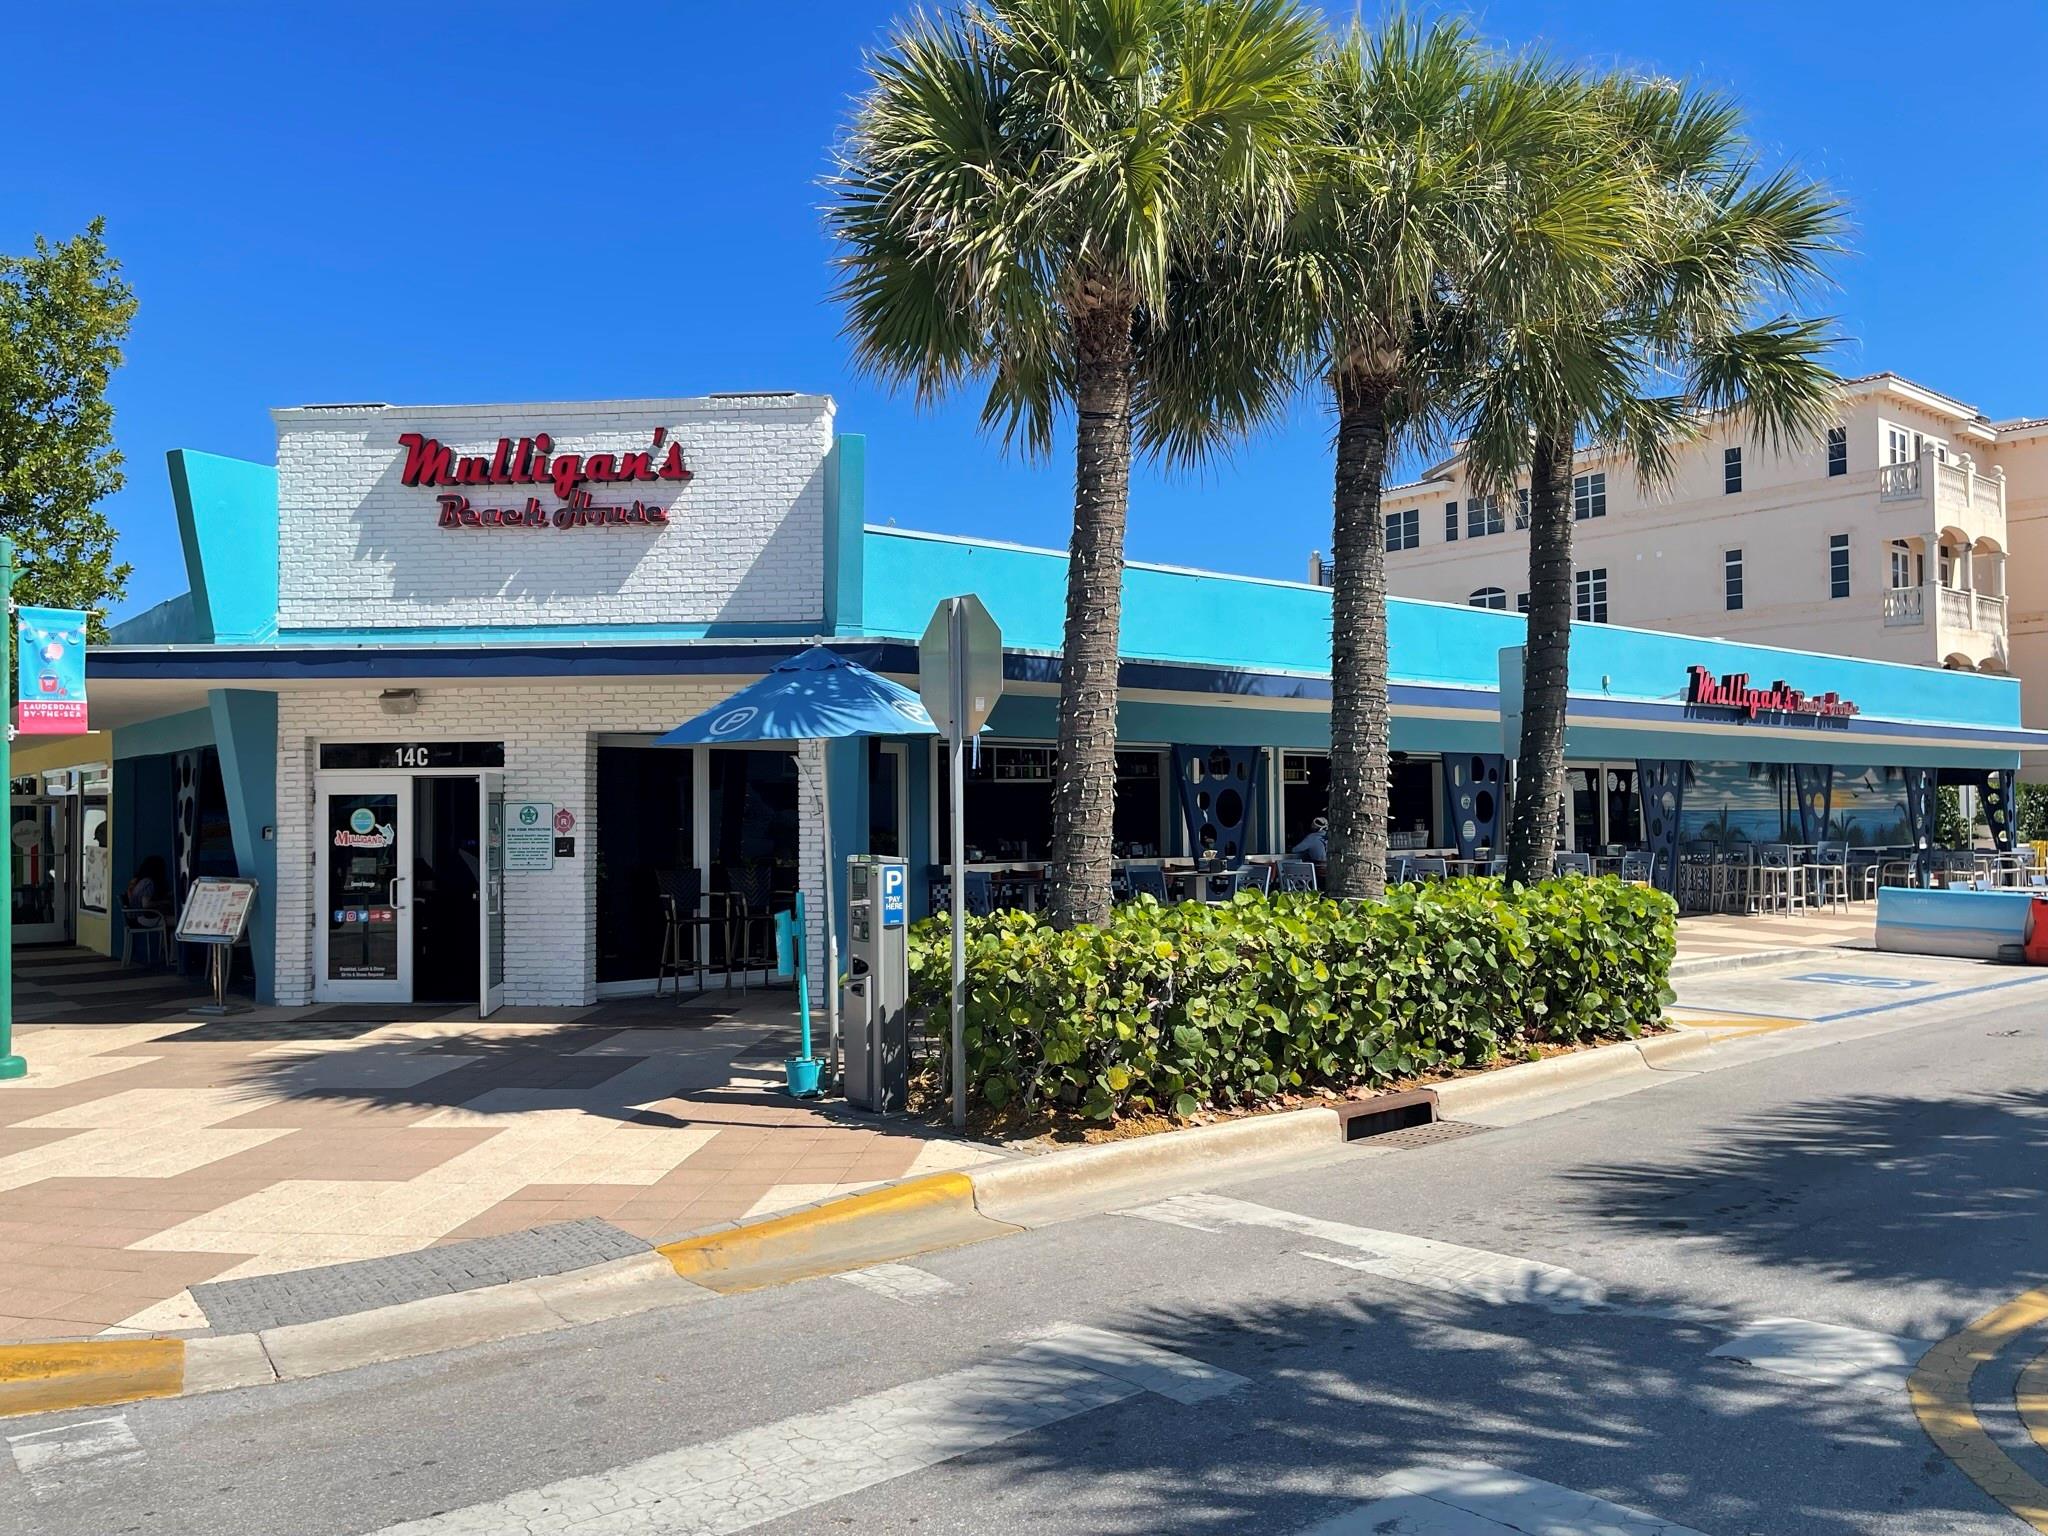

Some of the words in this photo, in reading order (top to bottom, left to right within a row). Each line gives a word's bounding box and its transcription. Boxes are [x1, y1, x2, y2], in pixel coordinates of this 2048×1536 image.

[398, 427, 694, 500] Mulligan's
[436, 494, 549, 528] Beach
[553, 488, 670, 530] House
[1687, 665, 1794, 719] Mulligan's
[24, 703, 81, 711] LAUDERDALE
[395, 746, 429, 767] 14C
[886, 870, 902, 895] P
[885, 902, 903, 911] HERE
[888, 895, 901, 903] PAY
